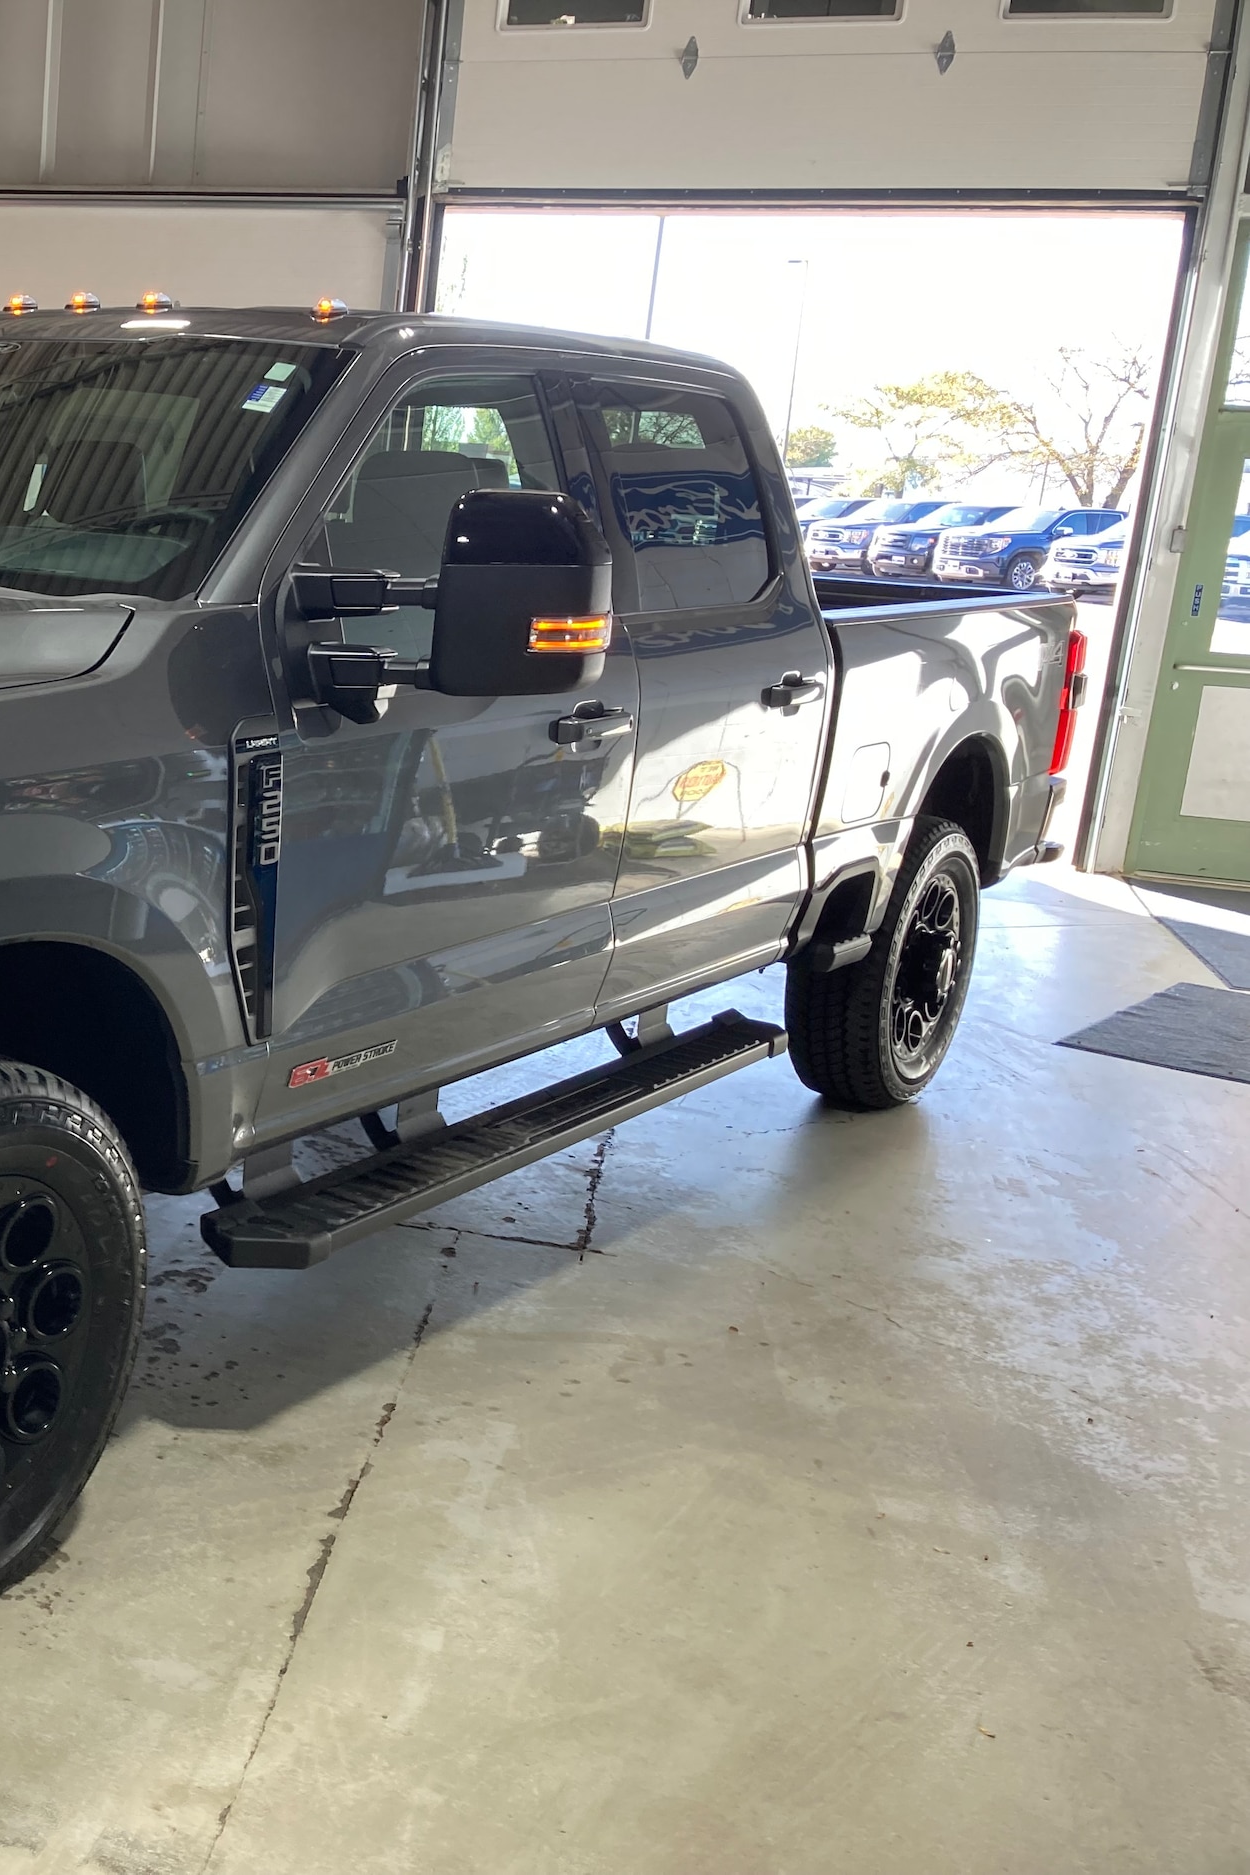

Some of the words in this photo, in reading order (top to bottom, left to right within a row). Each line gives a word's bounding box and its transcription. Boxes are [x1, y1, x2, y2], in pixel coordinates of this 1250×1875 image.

[1193, 585, 1203, 612] PUSH
[331, 1053, 362, 1072] POWER
[362, 1042, 396, 1061] STROKE
